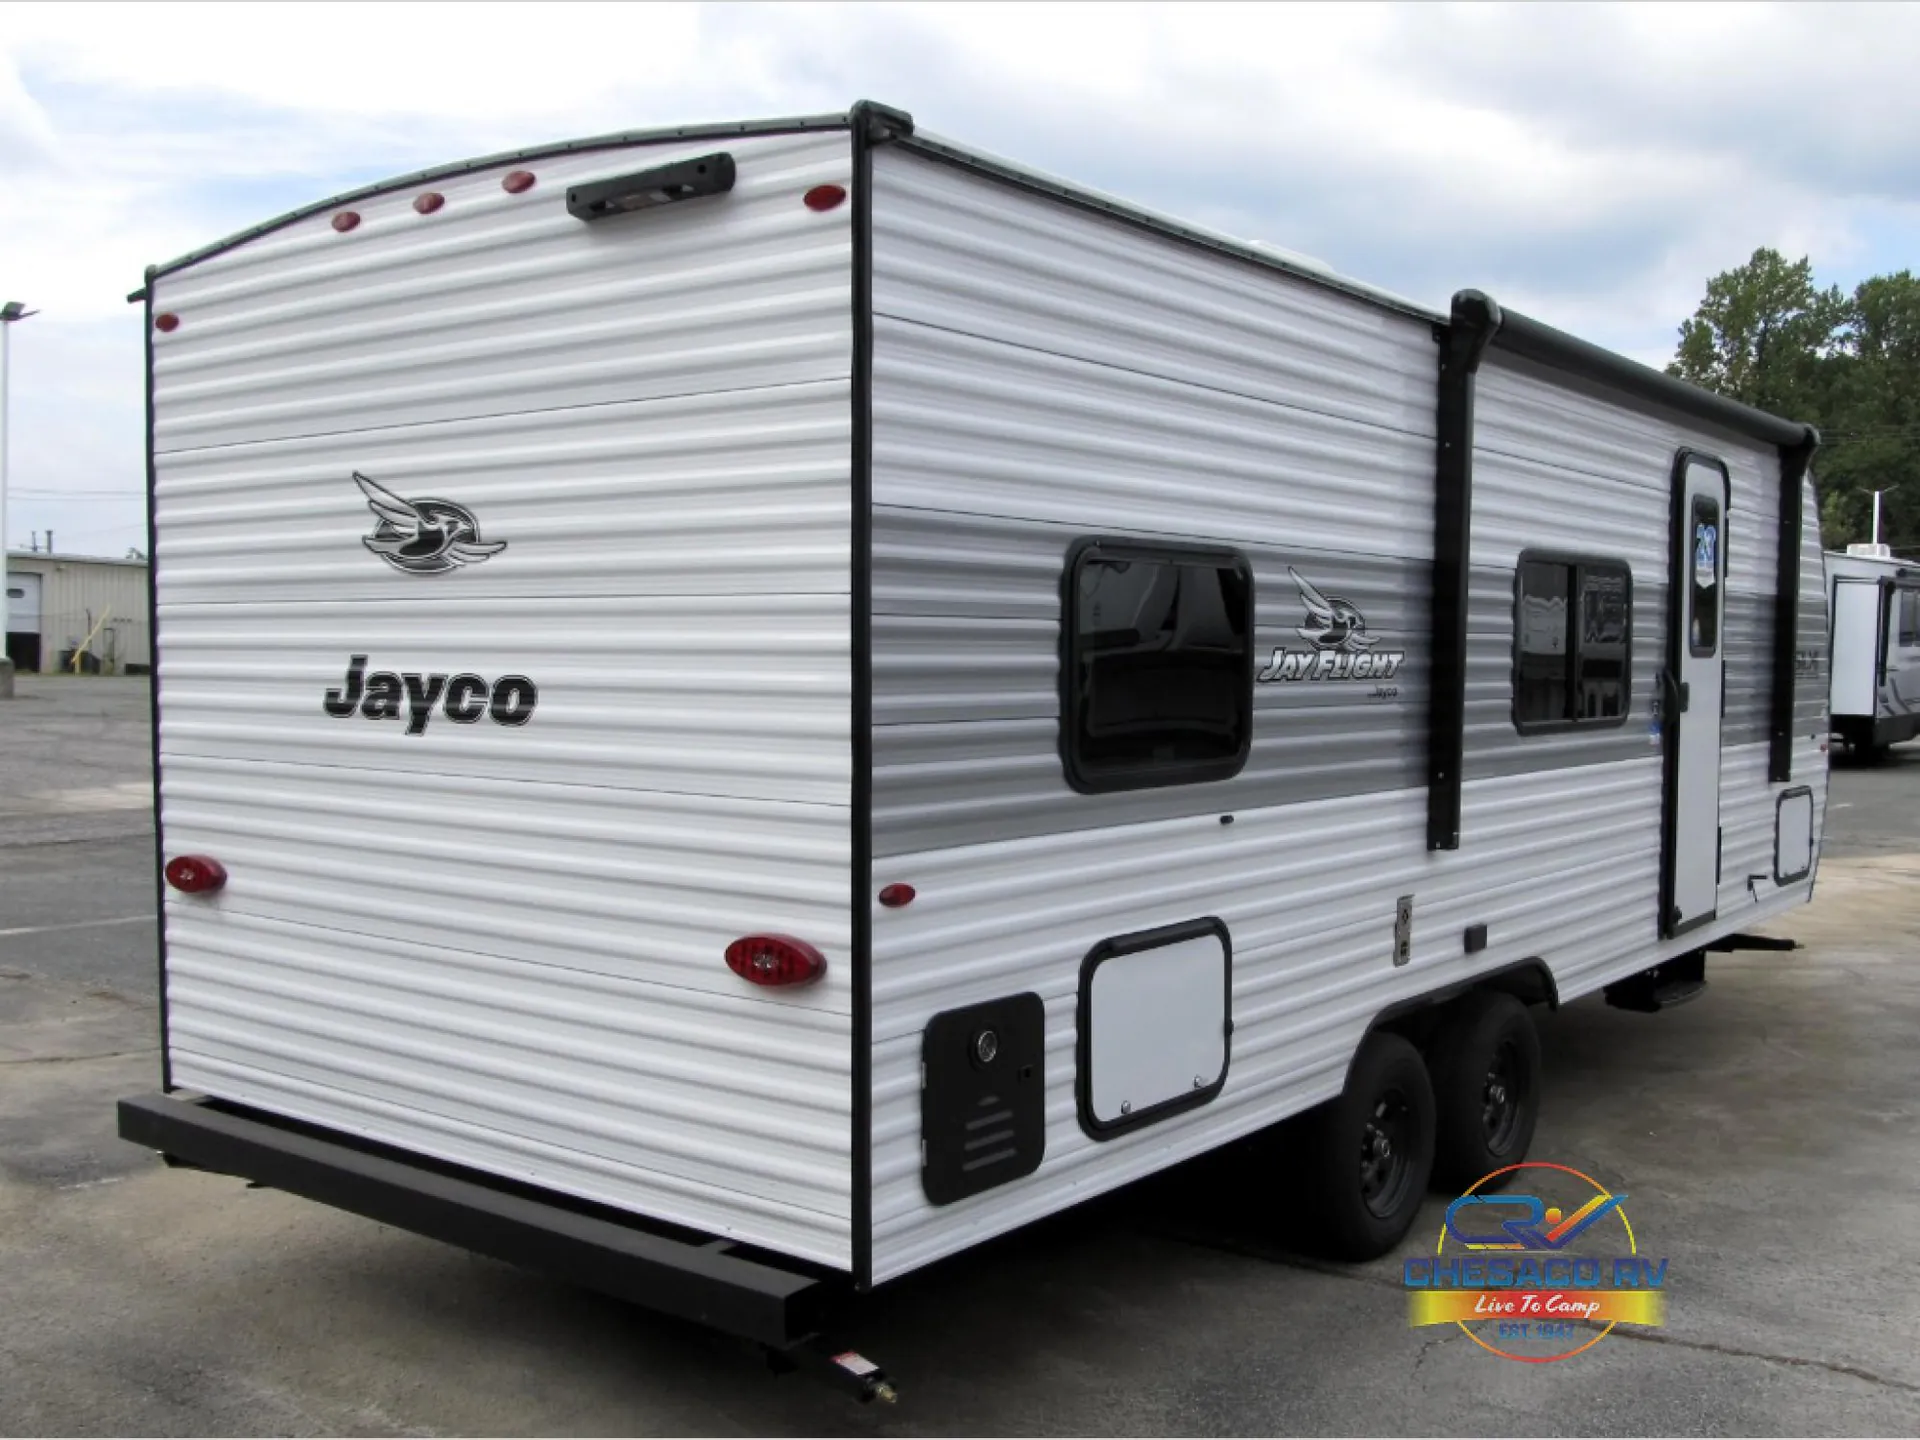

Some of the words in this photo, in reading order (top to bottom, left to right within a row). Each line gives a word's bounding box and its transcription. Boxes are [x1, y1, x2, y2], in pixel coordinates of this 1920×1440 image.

[1256, 647, 1315, 682] JAY
[1310, 650, 1405, 681] FLIGHT
[323, 654, 538, 736] Jayco
